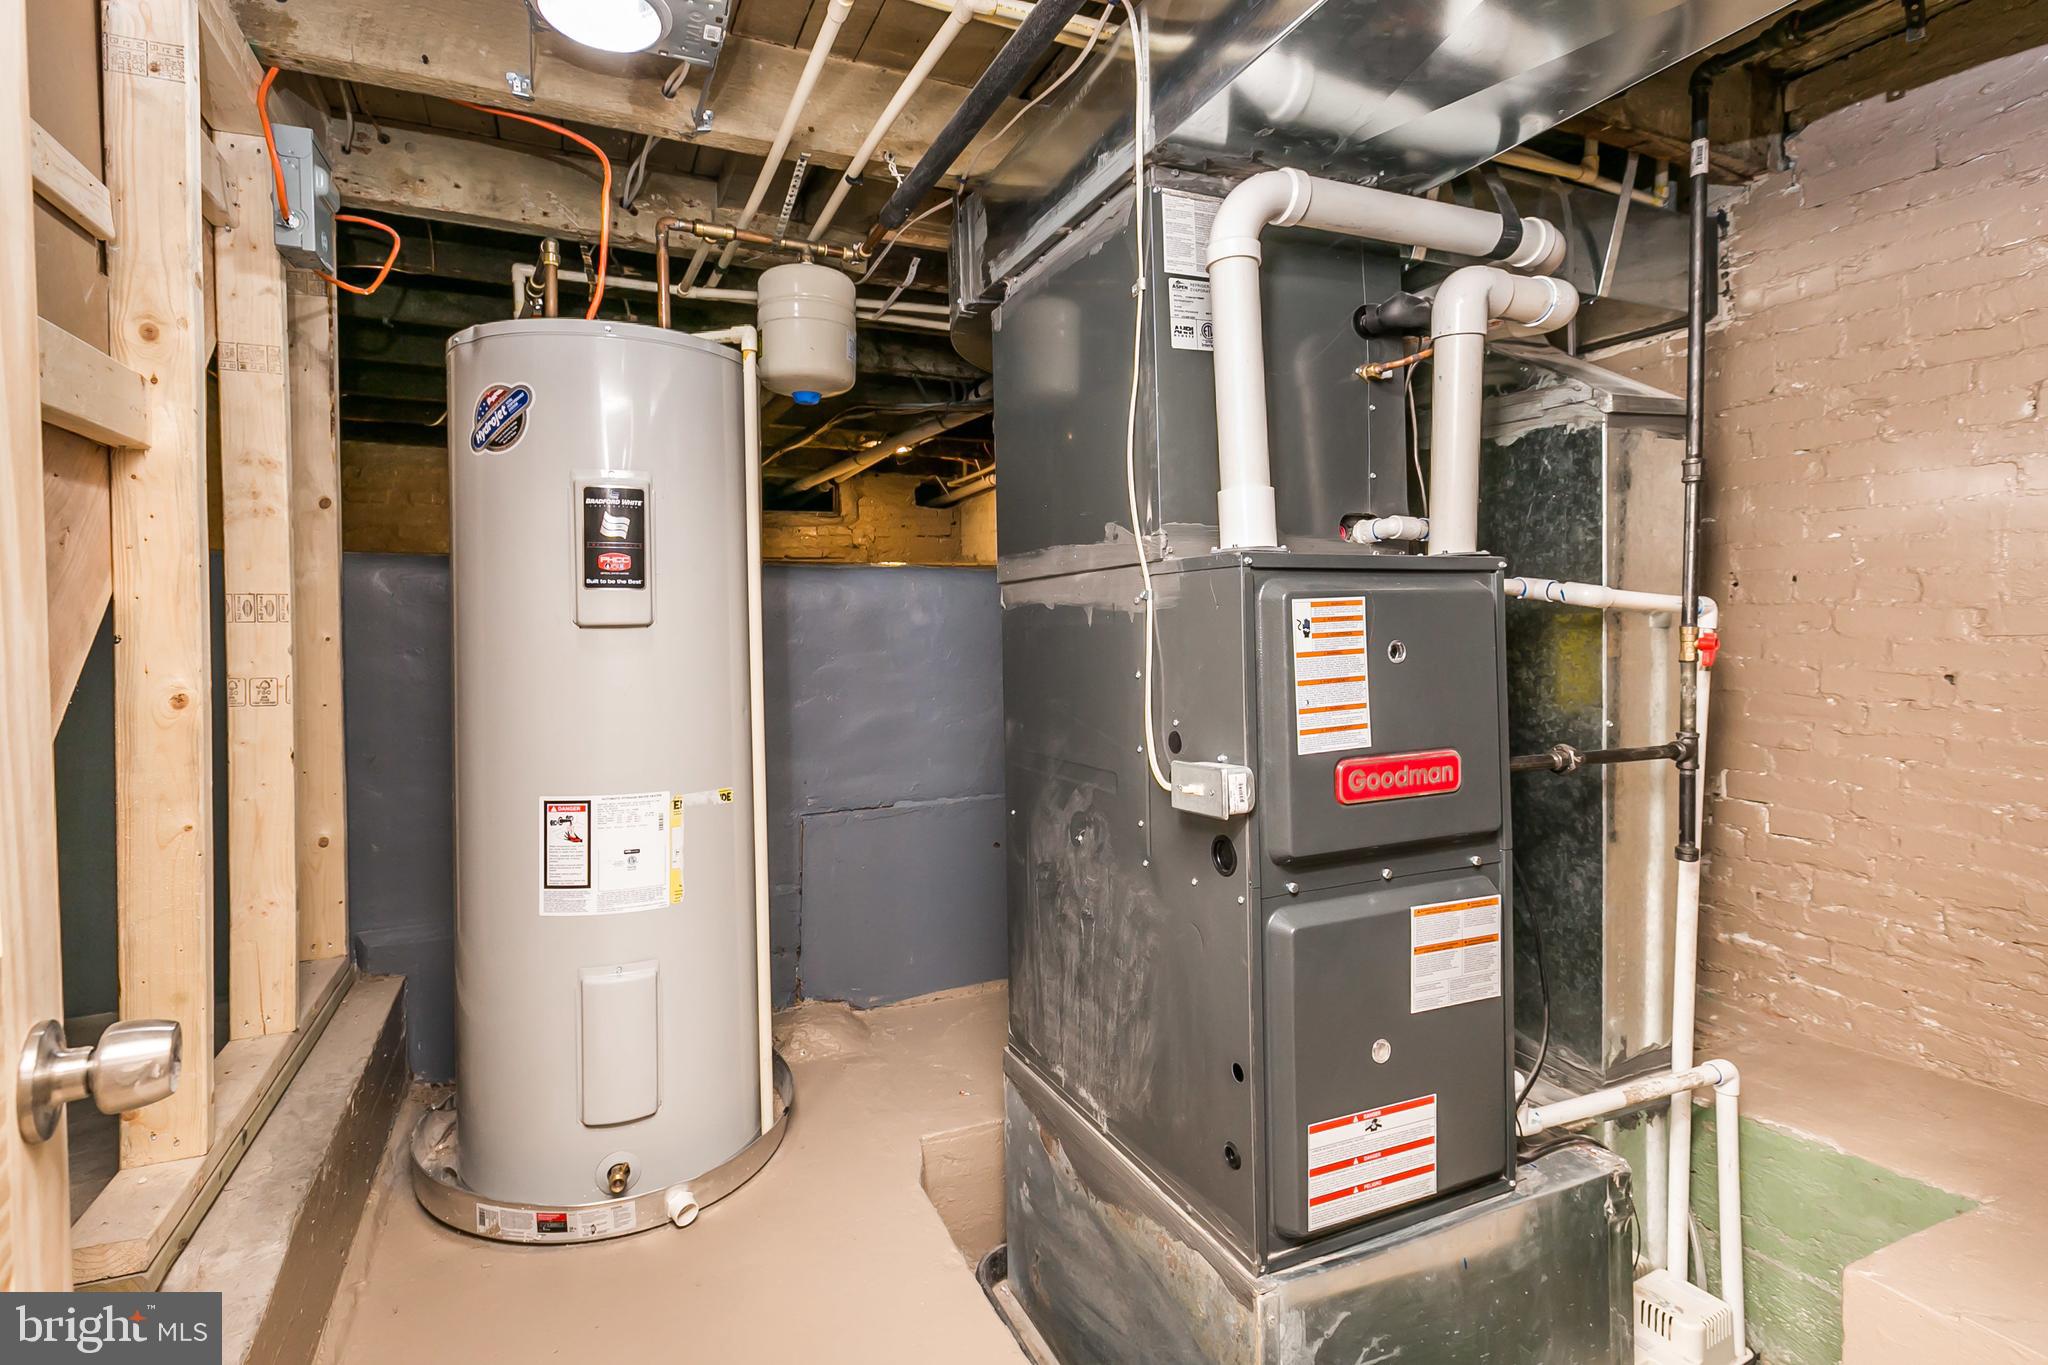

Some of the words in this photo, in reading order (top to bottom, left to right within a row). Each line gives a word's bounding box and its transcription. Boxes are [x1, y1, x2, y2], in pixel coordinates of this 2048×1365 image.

[476, 405, 507, 444] Hydrojet
[621, 499, 643, 507] WHITE
[1348, 764, 1454, 793] Goodman
